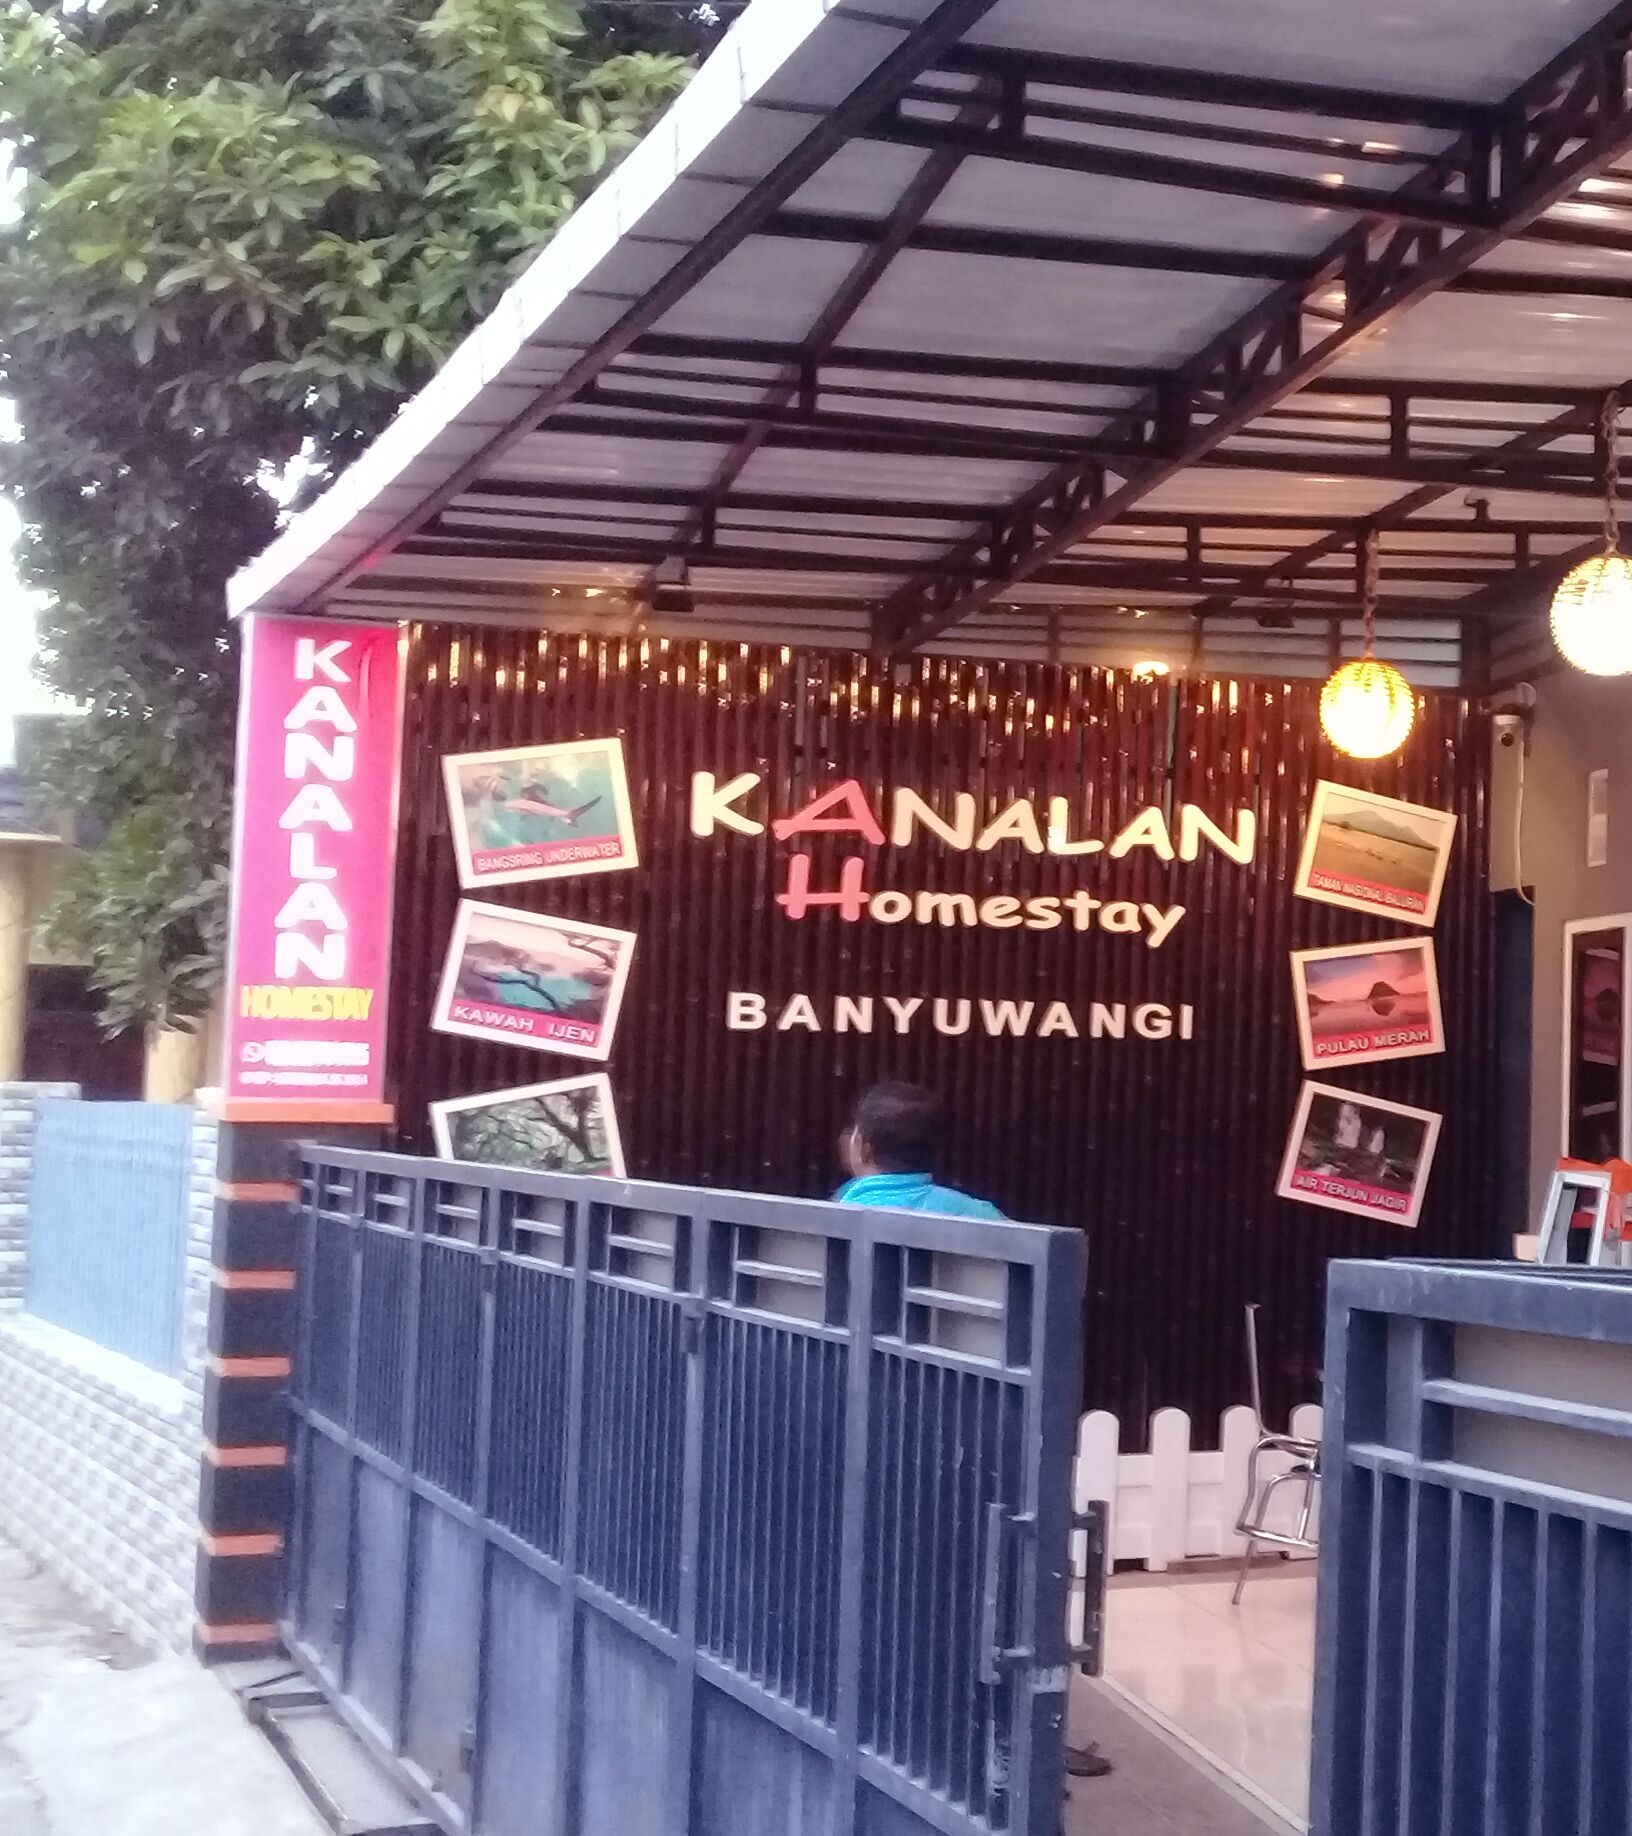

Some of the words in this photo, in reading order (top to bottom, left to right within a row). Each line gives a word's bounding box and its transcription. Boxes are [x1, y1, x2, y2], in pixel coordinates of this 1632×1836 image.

[274, 637, 358, 980] KANALAN
[690, 770, 1256, 864] KANALAN
[545, 841, 621, 864] UNDERWATER
[776, 853, 1186, 948] Homestay
[240, 984, 375, 1021] HOMESTAY
[726, 991, 1194, 1040] BANYUWANGI
[454, 1005, 534, 1032] KAWAH
[547, 1022, 596, 1043] IJEN
[1317, 1035, 1369, 1055] PULAU
[1374, 1029, 1430, 1048] MERAH
[1296, 1175, 1319, 1190] AIR
[1321, 1180, 1369, 1202] TERJUN
